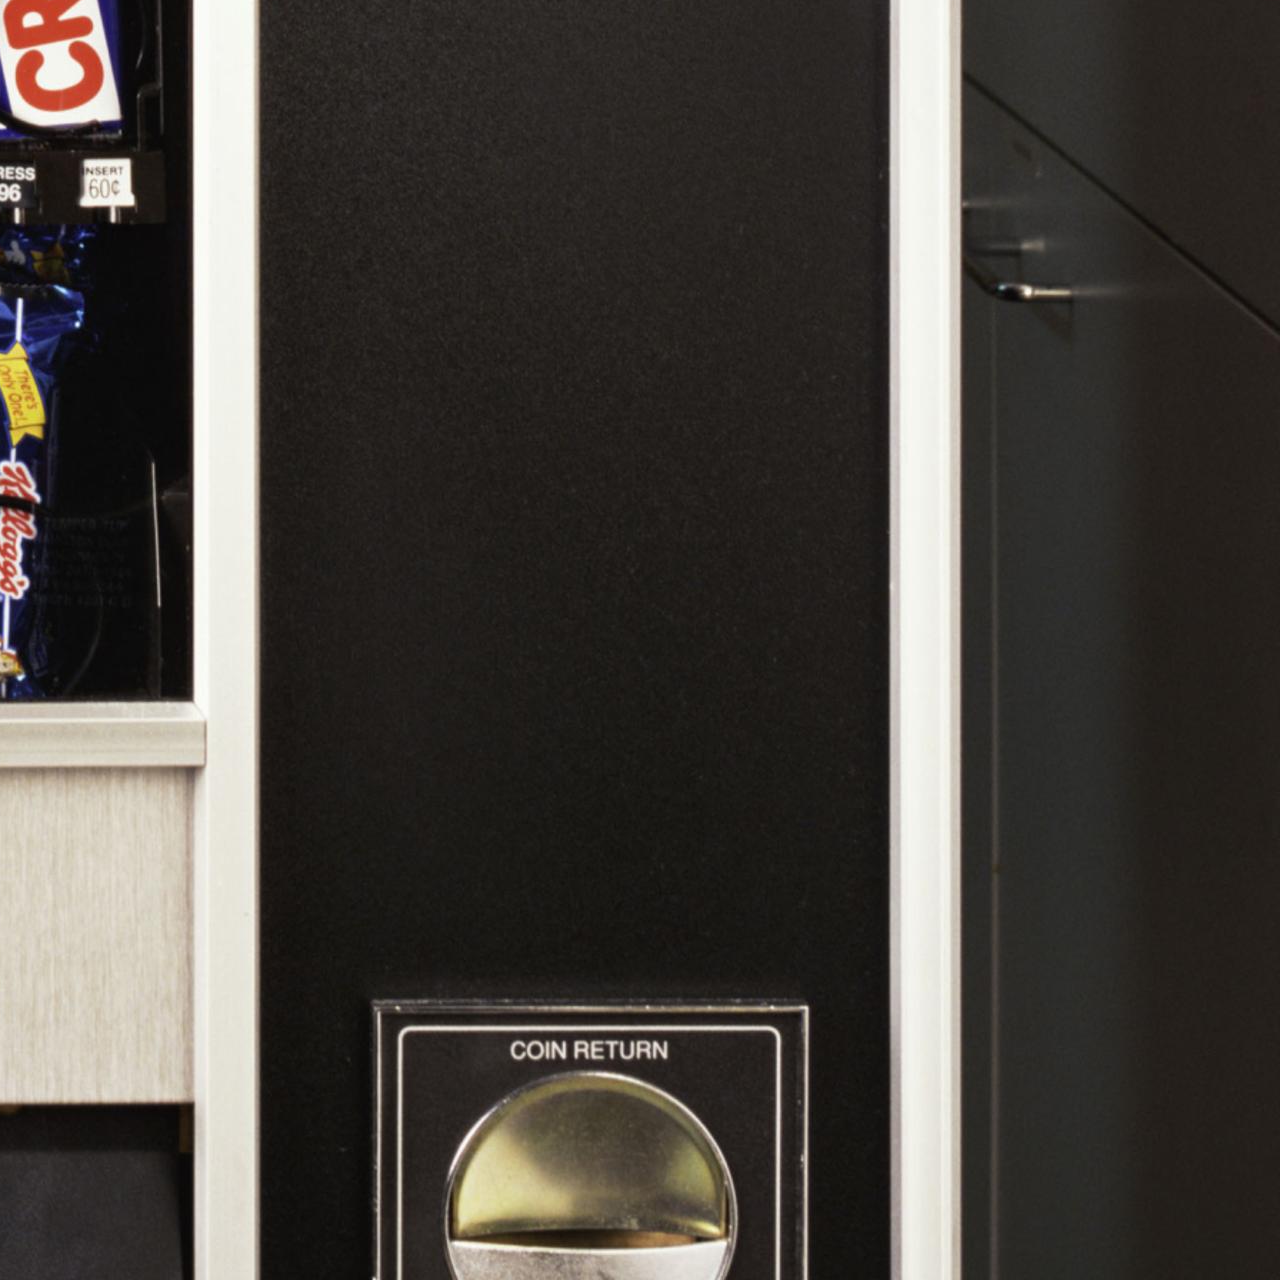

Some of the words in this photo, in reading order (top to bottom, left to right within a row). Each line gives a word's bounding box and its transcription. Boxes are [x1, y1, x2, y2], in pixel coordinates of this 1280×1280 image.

[14, 368, 37, 409] There's
[6, 395, 26, 424] One!
[510, 1041, 566, 1060] COIN
[574, 1041, 668, 1059] RETURN
